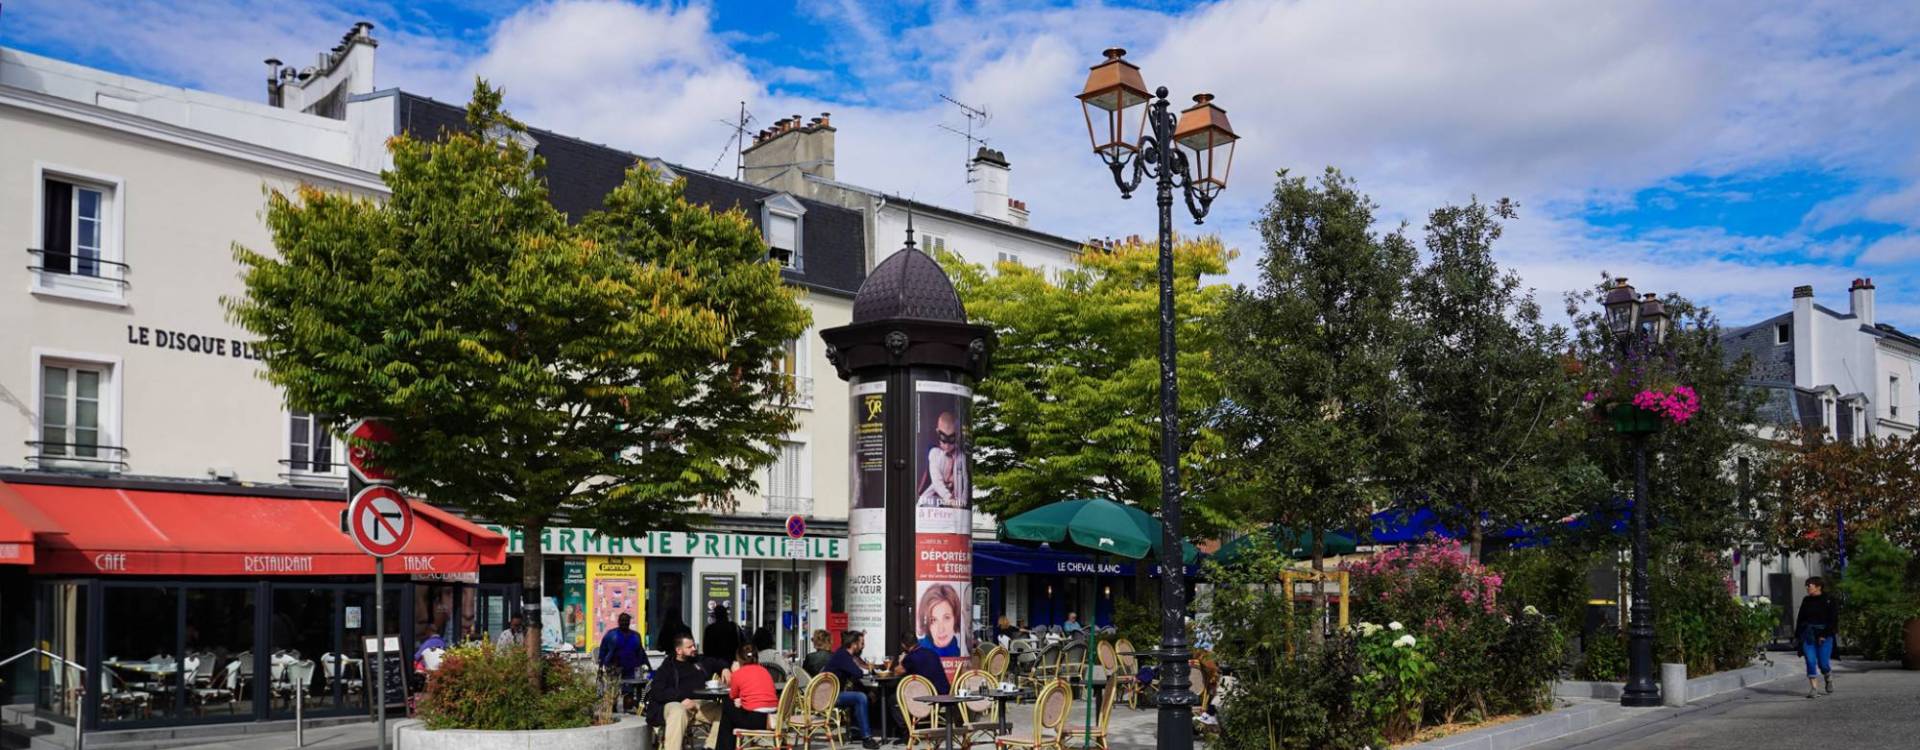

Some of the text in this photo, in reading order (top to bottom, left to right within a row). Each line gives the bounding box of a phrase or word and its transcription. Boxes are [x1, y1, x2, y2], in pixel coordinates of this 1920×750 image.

[128, 325, 149, 346] LE
[155, 329, 226, 356] DISQUE
[920, 548, 967, 562] DÉPORTÉS
[244, 555, 313, 572] RESTAURANT
[404, 556, 435, 571] TABAC
[1057, 562, 1066, 572] LE
[1067, 562, 1096, 573] CHEVAL
